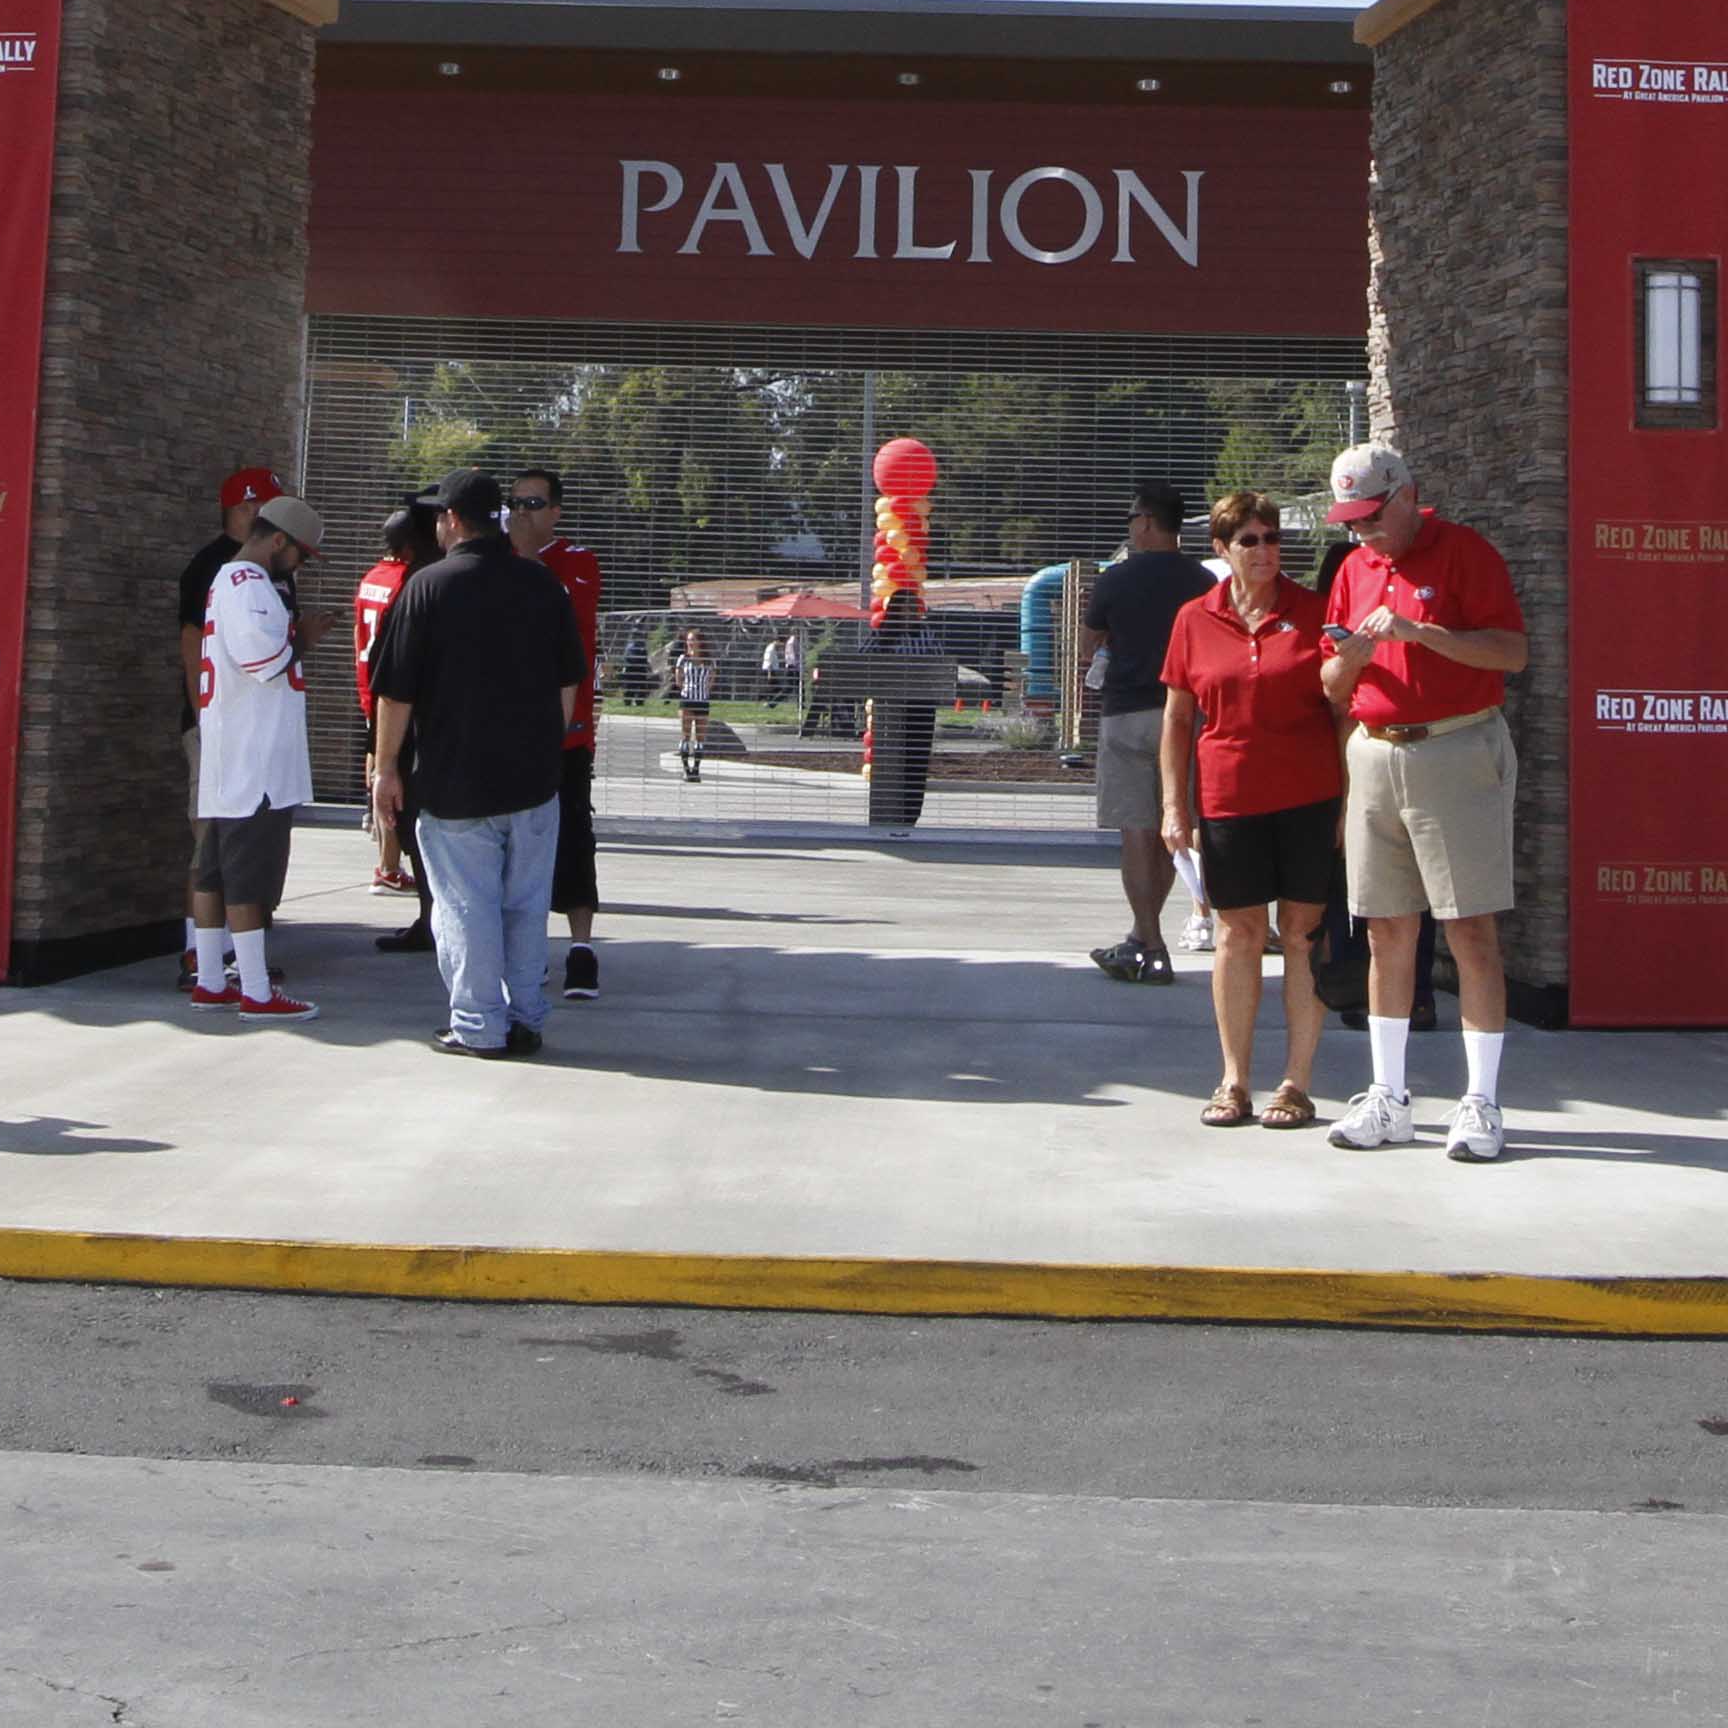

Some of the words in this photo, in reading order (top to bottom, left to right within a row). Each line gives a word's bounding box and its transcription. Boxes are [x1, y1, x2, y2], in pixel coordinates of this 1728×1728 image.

[1592, 63, 1633, 88] RED
[1639, 65, 1687, 91] ZONE
[616, 160, 1206, 268] PAVILION
[1595, 524, 1635, 549] RED
[1642, 525, 1691, 550] ZONE
[1596, 694, 1636, 720] RED
[1642, 695, 1693, 720] ZONE
[1597, 867, 1635, 892] RED
[1643, 867, 1693, 892] ZONE
